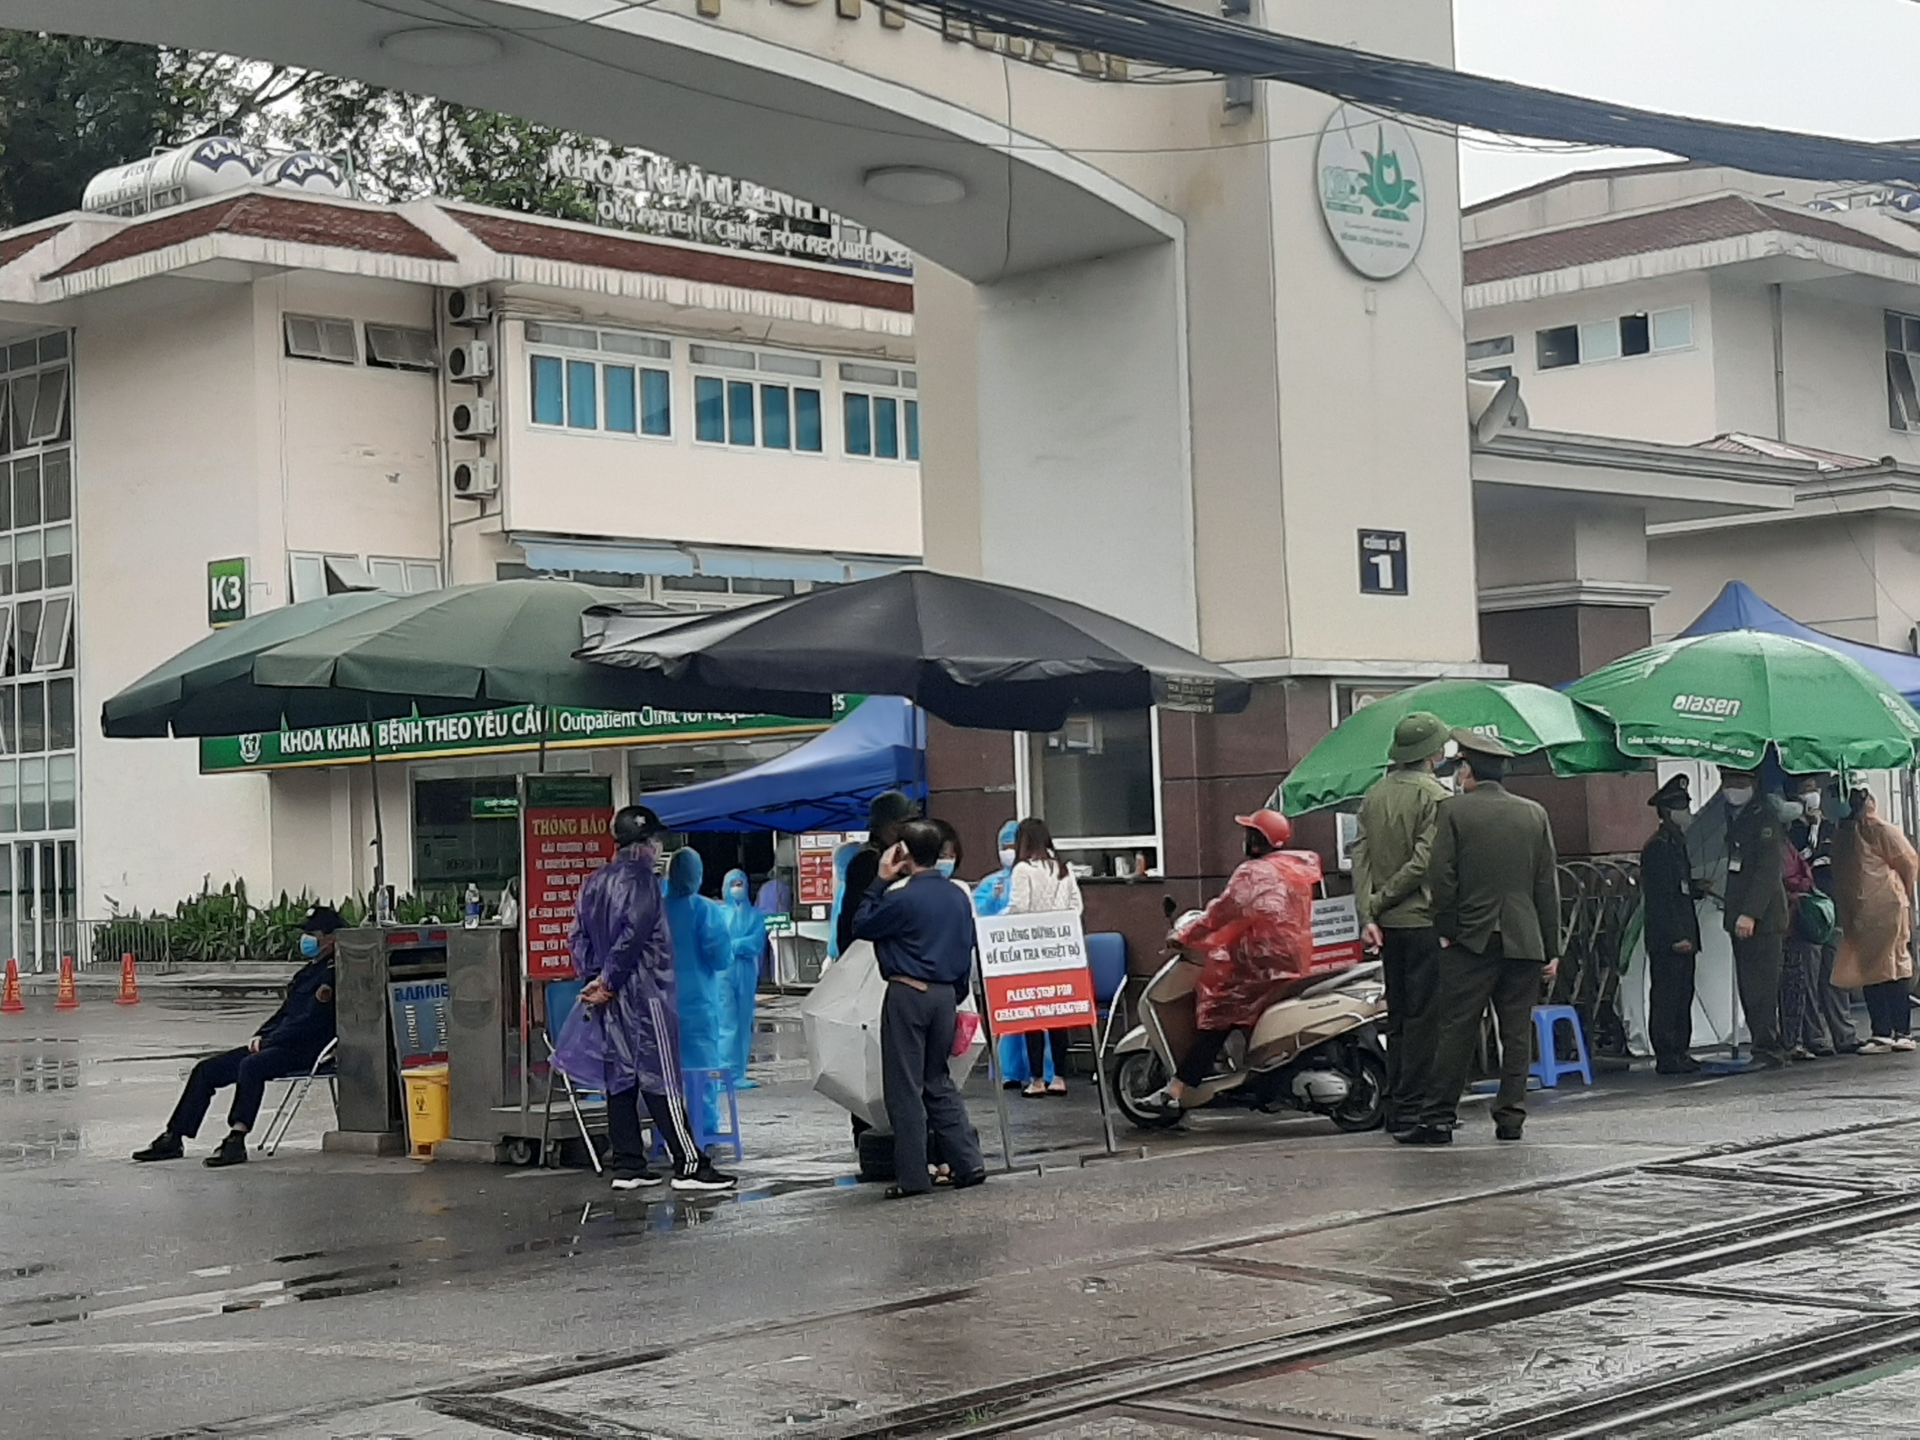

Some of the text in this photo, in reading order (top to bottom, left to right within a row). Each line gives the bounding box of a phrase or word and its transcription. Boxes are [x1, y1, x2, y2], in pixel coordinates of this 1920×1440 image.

[772, 230, 806, 251] FOR
[1369, 553, 1394, 589] 1
[211, 576, 242, 611] K3
[280, 729, 325, 753] KHOA
[378, 717, 422, 751] BỆNH
[425, 716, 472, 742] THEO
[474, 709, 508, 739] YÊU
[559, 710, 638, 735] Outpatient
[531, 812, 607, 836] THÔNG BÁO
